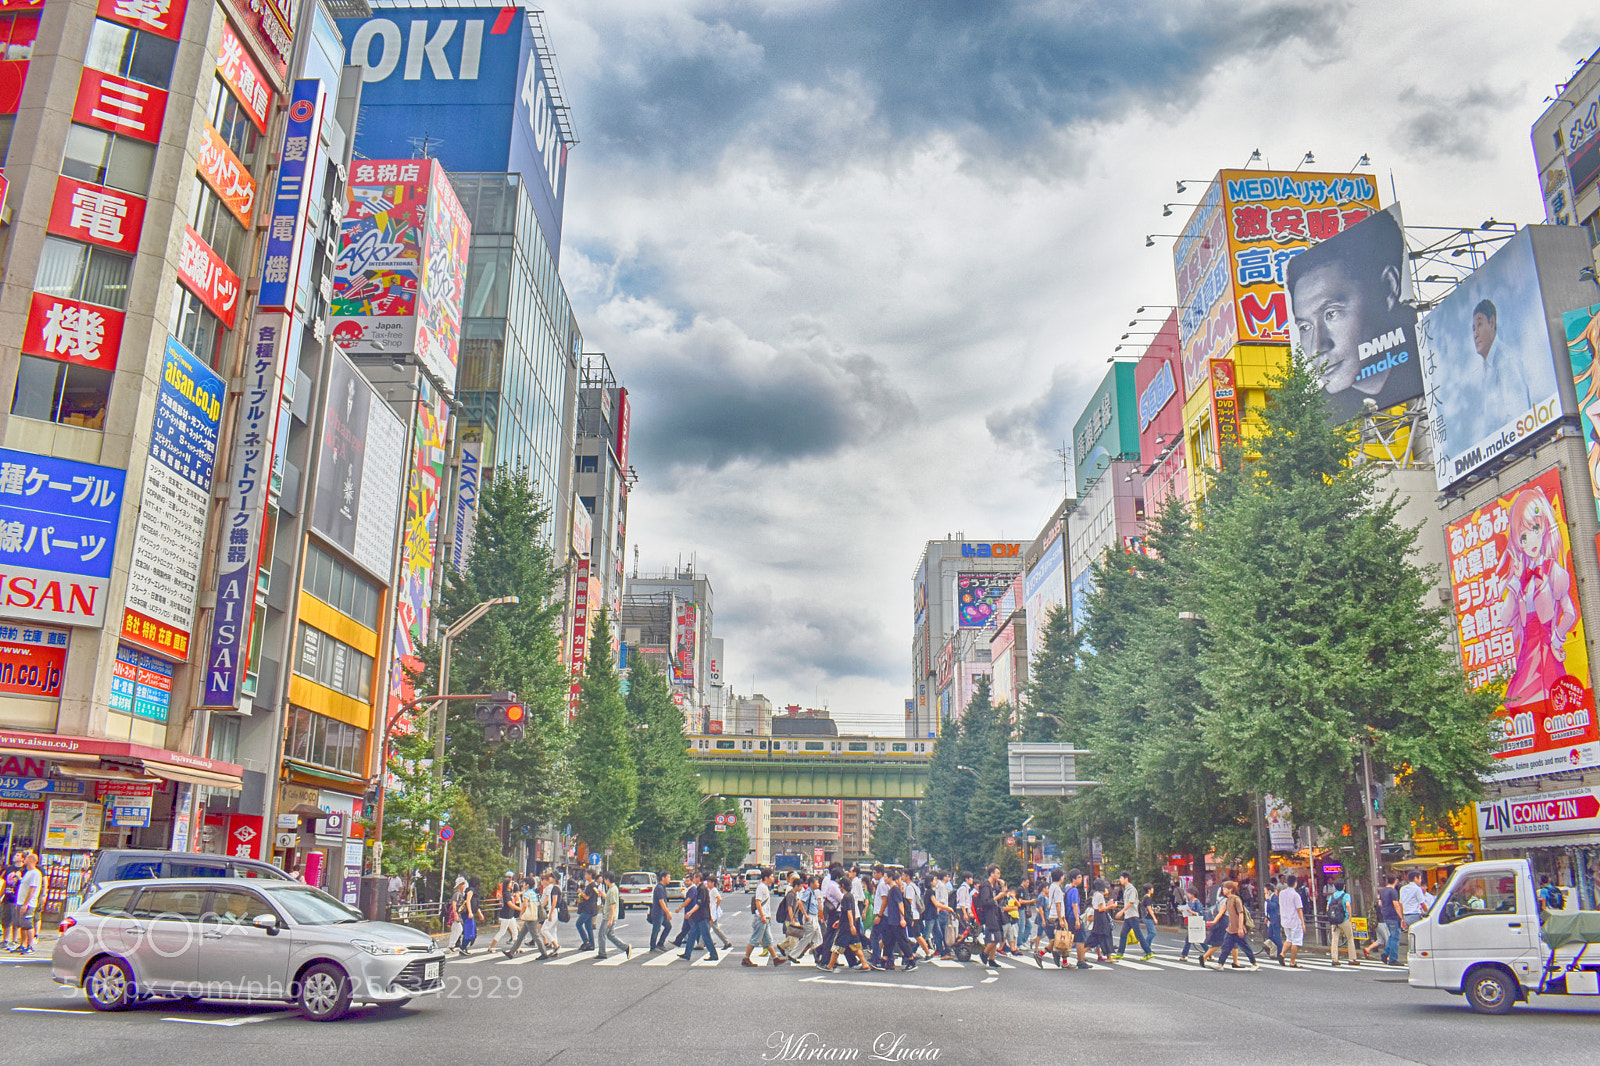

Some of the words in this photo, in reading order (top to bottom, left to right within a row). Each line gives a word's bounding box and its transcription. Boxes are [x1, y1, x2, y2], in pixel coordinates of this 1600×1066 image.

[217, 34, 269, 123] 光通信
[521, 49, 562, 198] AOKI
[1570, 94, 1600, 150] メイ
[200, 128, 255, 214] ネットワーク
[355, 164, 420, 183] 免税店
[264, 135, 308, 284] 愛三電機
[1228, 177, 1374, 204] MEDIAリサイクル
[178, 232, 238, 311] 配線パーツ
[371, 331, 403, 339] Tax-free
[382, 339, 402, 348] Shop
[1357, 327, 1406, 361] DMM
[164, 362, 221, 422] aisan.co.jp
[1140, 359, 1177, 434] SEGA
[1218, 416, 1235, 424] ゲーム
[1516, 399, 1555, 437] solar
[227, 326, 276, 563] 各種ケーブル・ネットワーク機器
[458, 449, 477, 510] AKKY
[453, 494, 465, 573] INTERNATIONA
[1450, 506, 1509, 555] あみあみ
[1453, 540, 1498, 584] 秋葉原
[1458, 572, 1502, 612] ラジオ
[126, 613, 141, 634] 各社
[142, 620, 157, 642] 特約
[158, 627, 173, 647] 在庫
[173, 633, 187, 652] 直販
[211, 579, 240, 692] AISAN
[685, 605, 694, 628] 免税店
[23, 629, 43, 643] 在庫
[47, 632, 67, 645] 直販
[684, 629, 693, 651] DUTY
[1465, 631, 1516, 666] 7月15日
[684, 652, 692, 676] FREE
[1544, 709, 1589, 733] amiami
[1530, 759, 1544, 770] goods
[1554, 756, 1567, 764] more
[1480, 799, 1511, 833] ZIN
[1512, 802, 1556, 823] COMIC
[1558, 800, 1579, 819] ZIN
[1514, 823, 1550, 832] Akihabara
